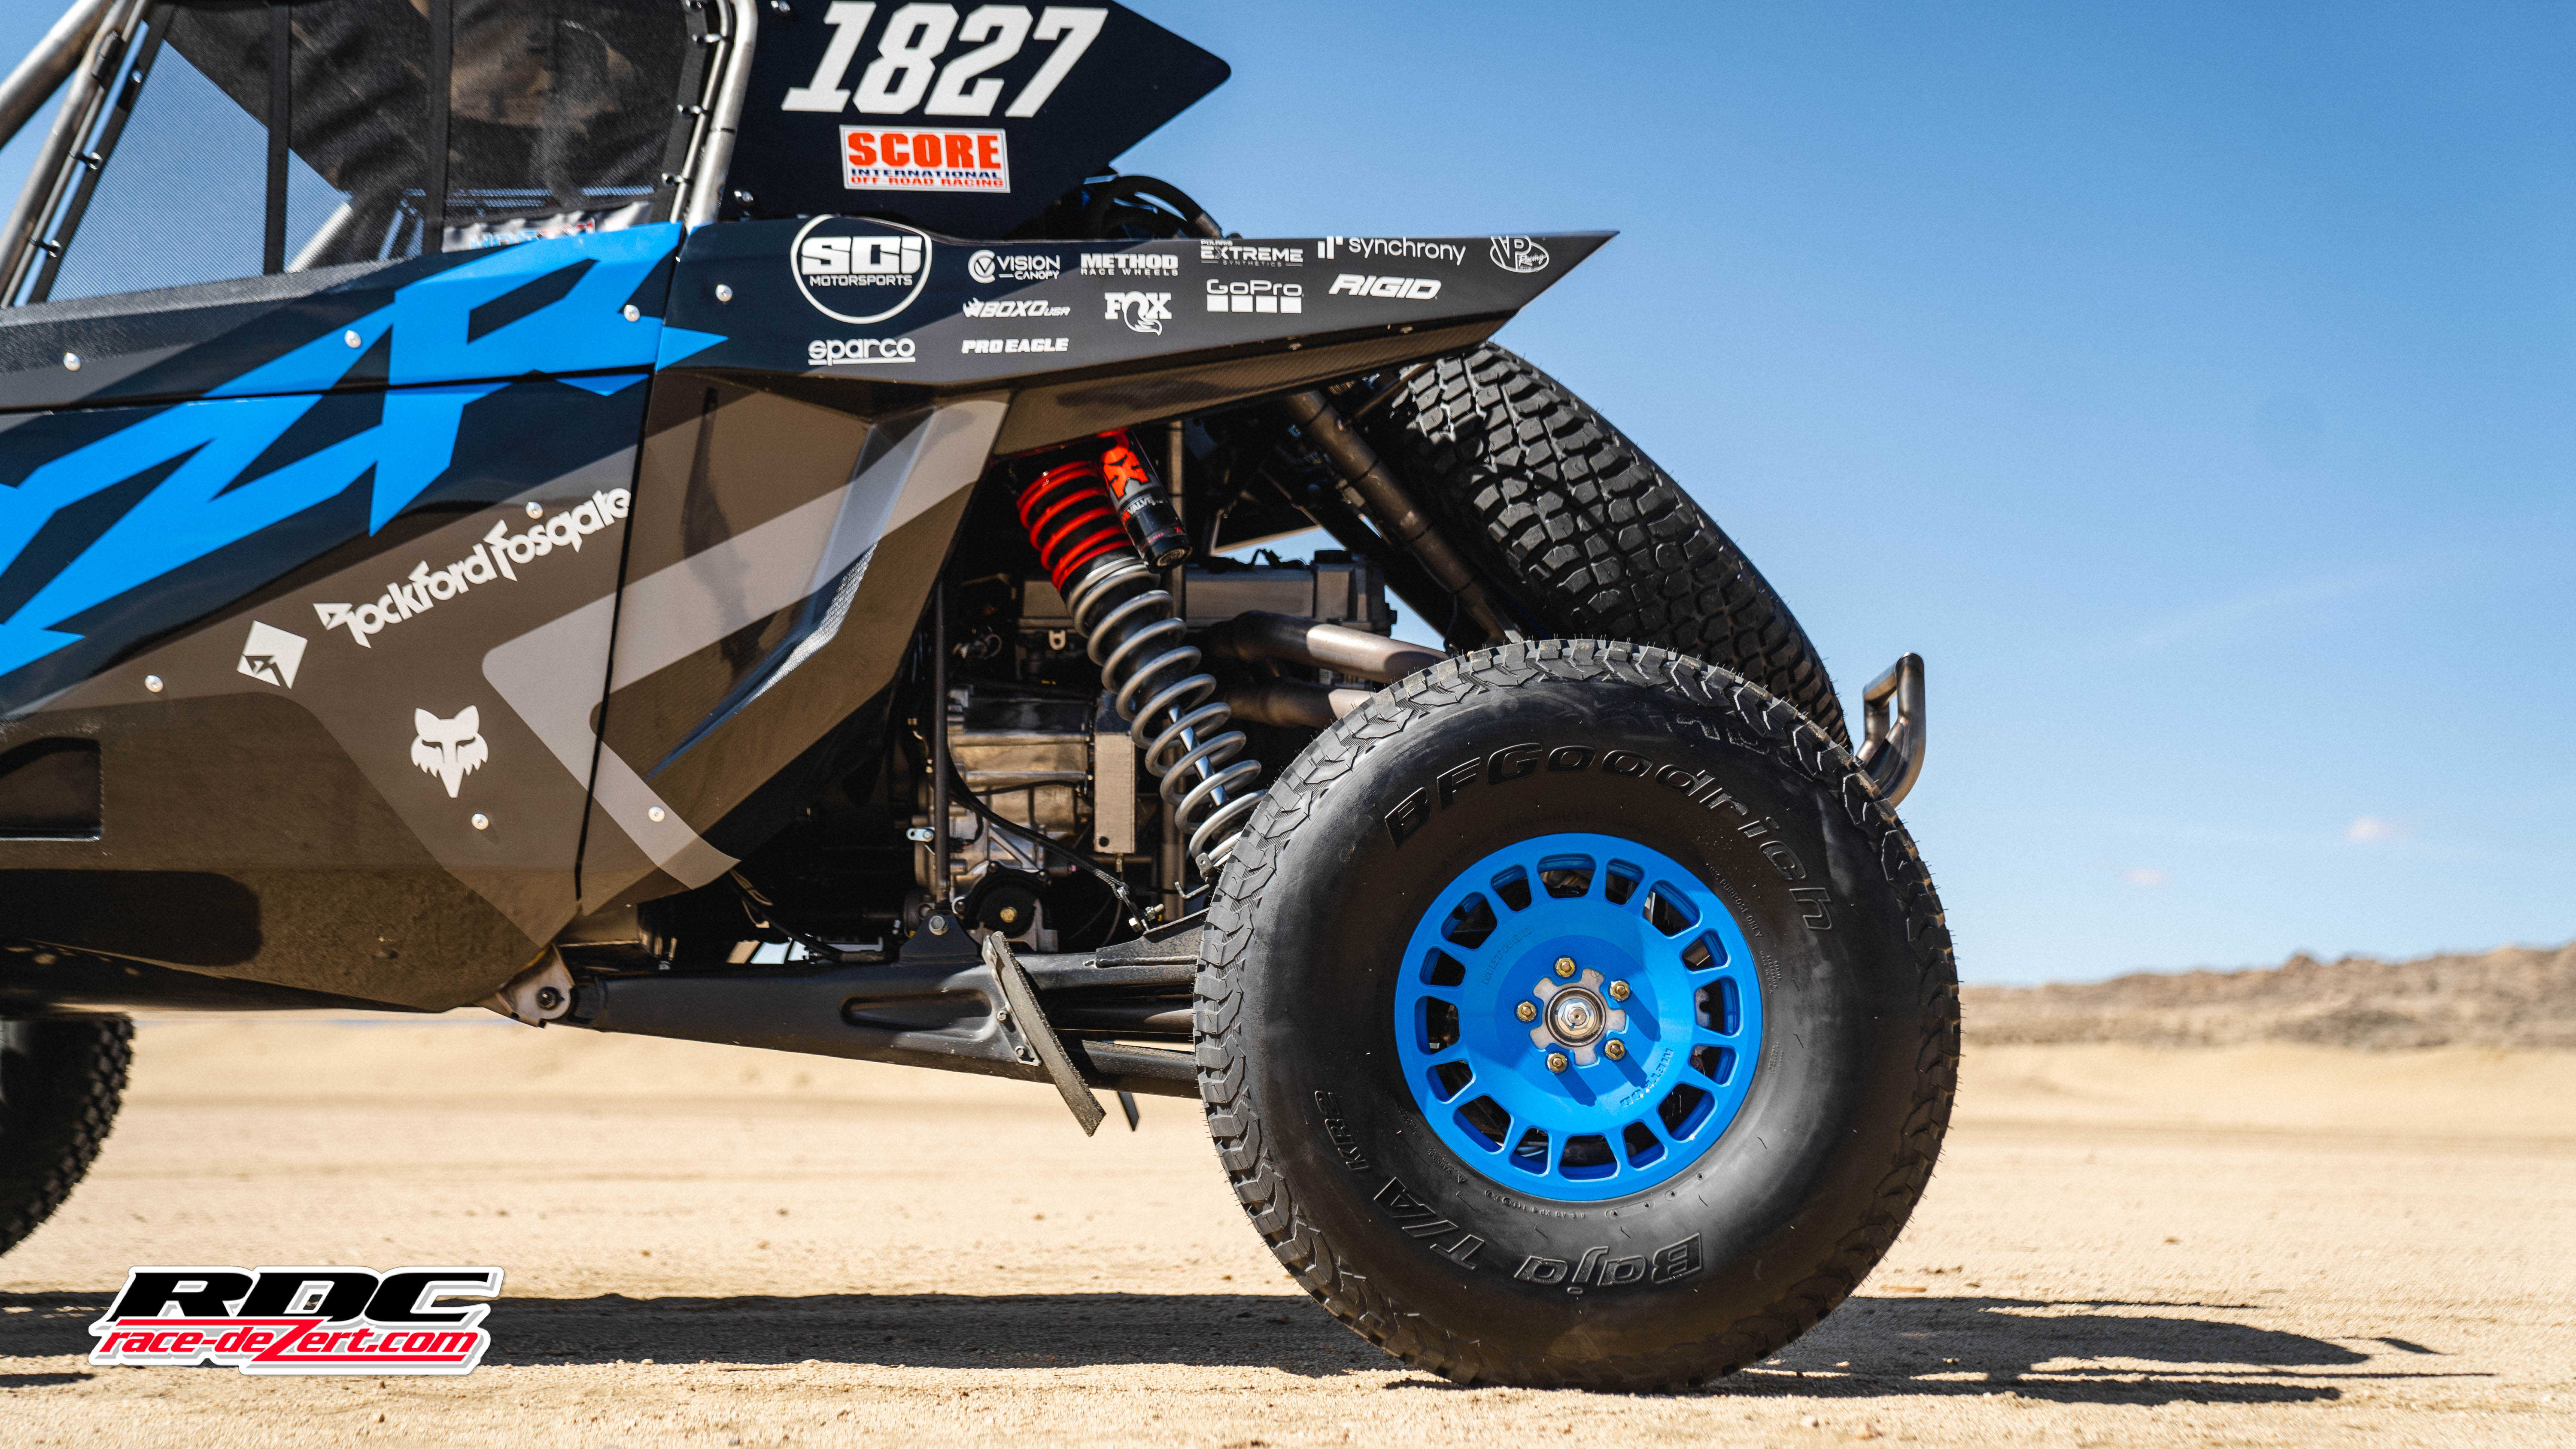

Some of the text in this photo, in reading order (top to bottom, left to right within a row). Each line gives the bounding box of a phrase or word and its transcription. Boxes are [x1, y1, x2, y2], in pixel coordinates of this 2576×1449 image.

[781, 1, 1109, 117] 1827
[848, 133, 1001, 169] SCORE
[851, 169, 1002, 178] INTERNATIONAL
[941, 179, 1003, 187] RACING
[1081, 253, 1179, 269] METHOD
[1200, 246, 1304, 263] EXTREME
[1349, 237, 1466, 265] synchrony
[996, 255, 1060, 271] VISION
[809, 275, 913, 286] MOTORSPORTS
[1015, 270, 1060, 280] CANOPY
[1206, 279, 1302, 296] GoPro
[1328, 273, 1442, 300] RIGID
[1104, 291, 1172, 336] FOX
[808, 337, 916, 366] sparco
[961, 337, 1069, 354] PRO EAGLE
[1383, 743, 1833, 932] BFGoodrich
[1315, 1090, 1370, 1172] KR2
[1373, 1176, 1704, 1295] Baja T/A
